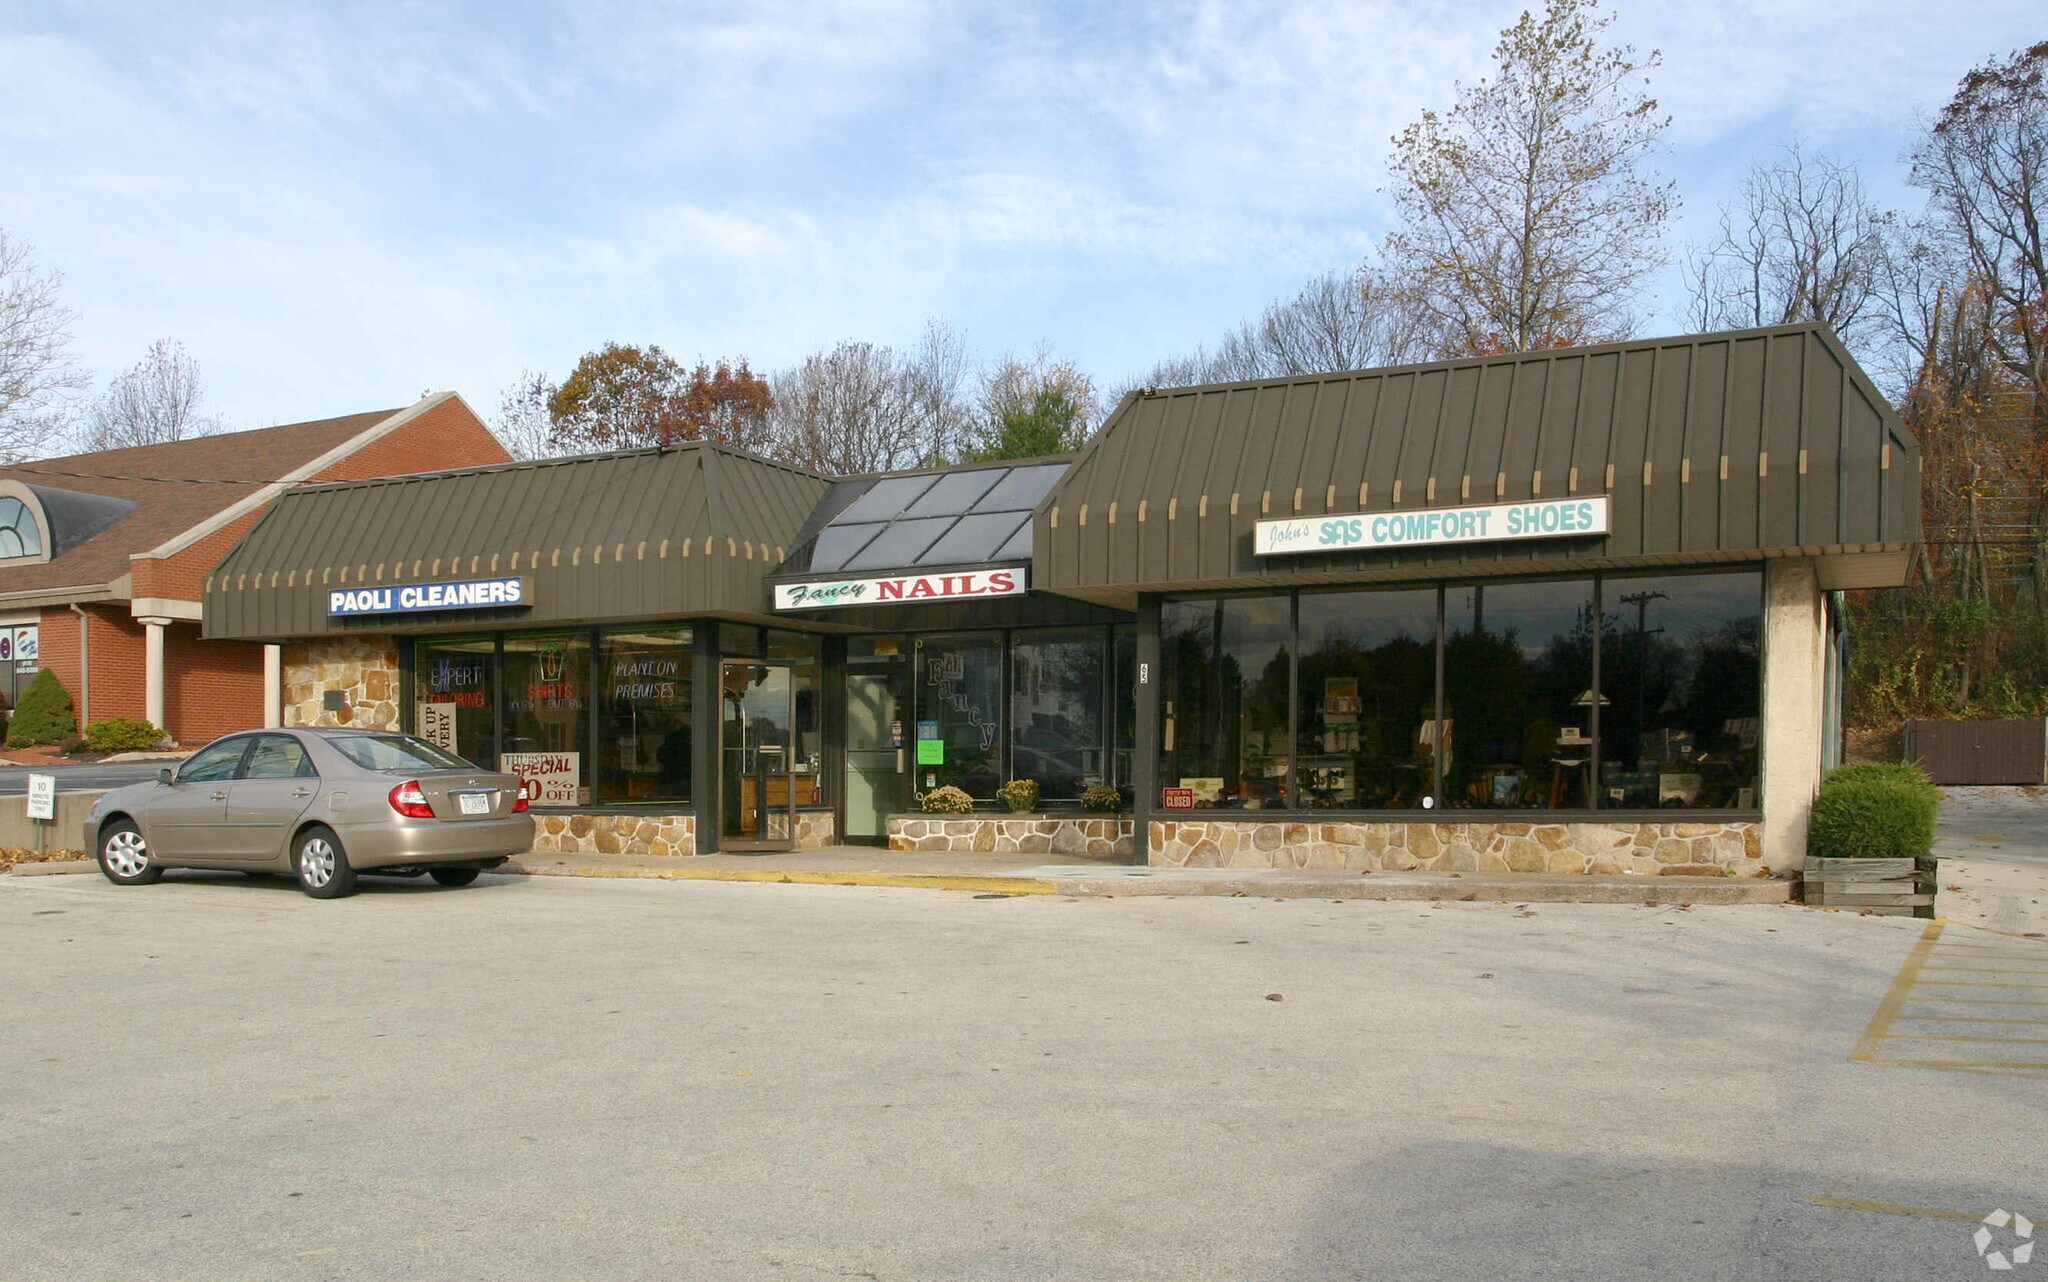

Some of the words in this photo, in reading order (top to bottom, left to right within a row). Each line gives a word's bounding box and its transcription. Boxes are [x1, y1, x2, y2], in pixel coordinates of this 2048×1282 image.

[1268, 522, 1311, 551] John's
[1318, 518, 1363, 546] SAS
[1371, 509, 1492, 543] COMFORT
[1506, 502, 1594, 534] SHOES
[330, 589, 392, 612] PAOLI
[400, 580, 521, 609] CLEANERS
[786, 583, 868, 607] Fancy
[875, 572, 1016, 600] NAILS
[615, 661, 655, 677] PLANT
[656, 660, 677, 676] ON
[615, 682, 676, 699] PREMISES
[426, 707, 436, 725] UP
[512, 758, 572, 777] SPECIAL
[37, 782, 47, 792] 10
[546, 791, 575, 801] OFF
[1166, 795, 1191, 807] CLOSED
